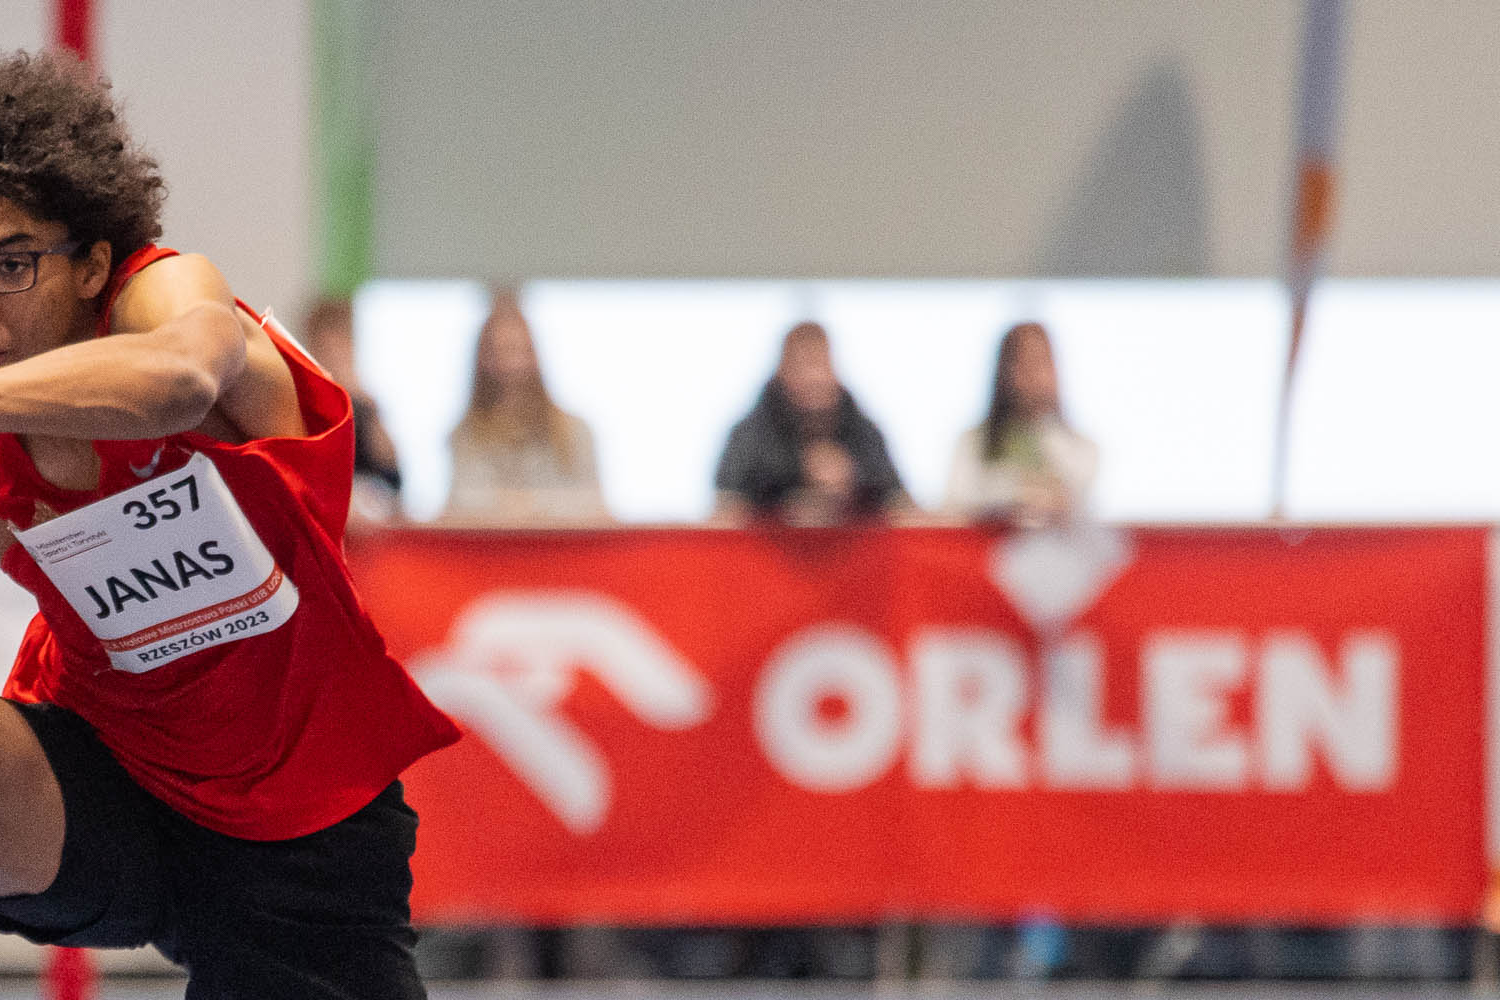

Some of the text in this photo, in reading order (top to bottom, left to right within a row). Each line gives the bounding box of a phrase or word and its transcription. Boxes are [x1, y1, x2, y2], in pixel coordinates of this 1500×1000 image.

[122, 474, 201, 530] 357
[84, 541, 235, 620] JANAS
[219, 599, 248, 616] Polski
[250, 590, 268, 605] U18
[137, 610, 270, 663] RZESZÓW 2023
[752, 621, 1401, 795] ORLEN
